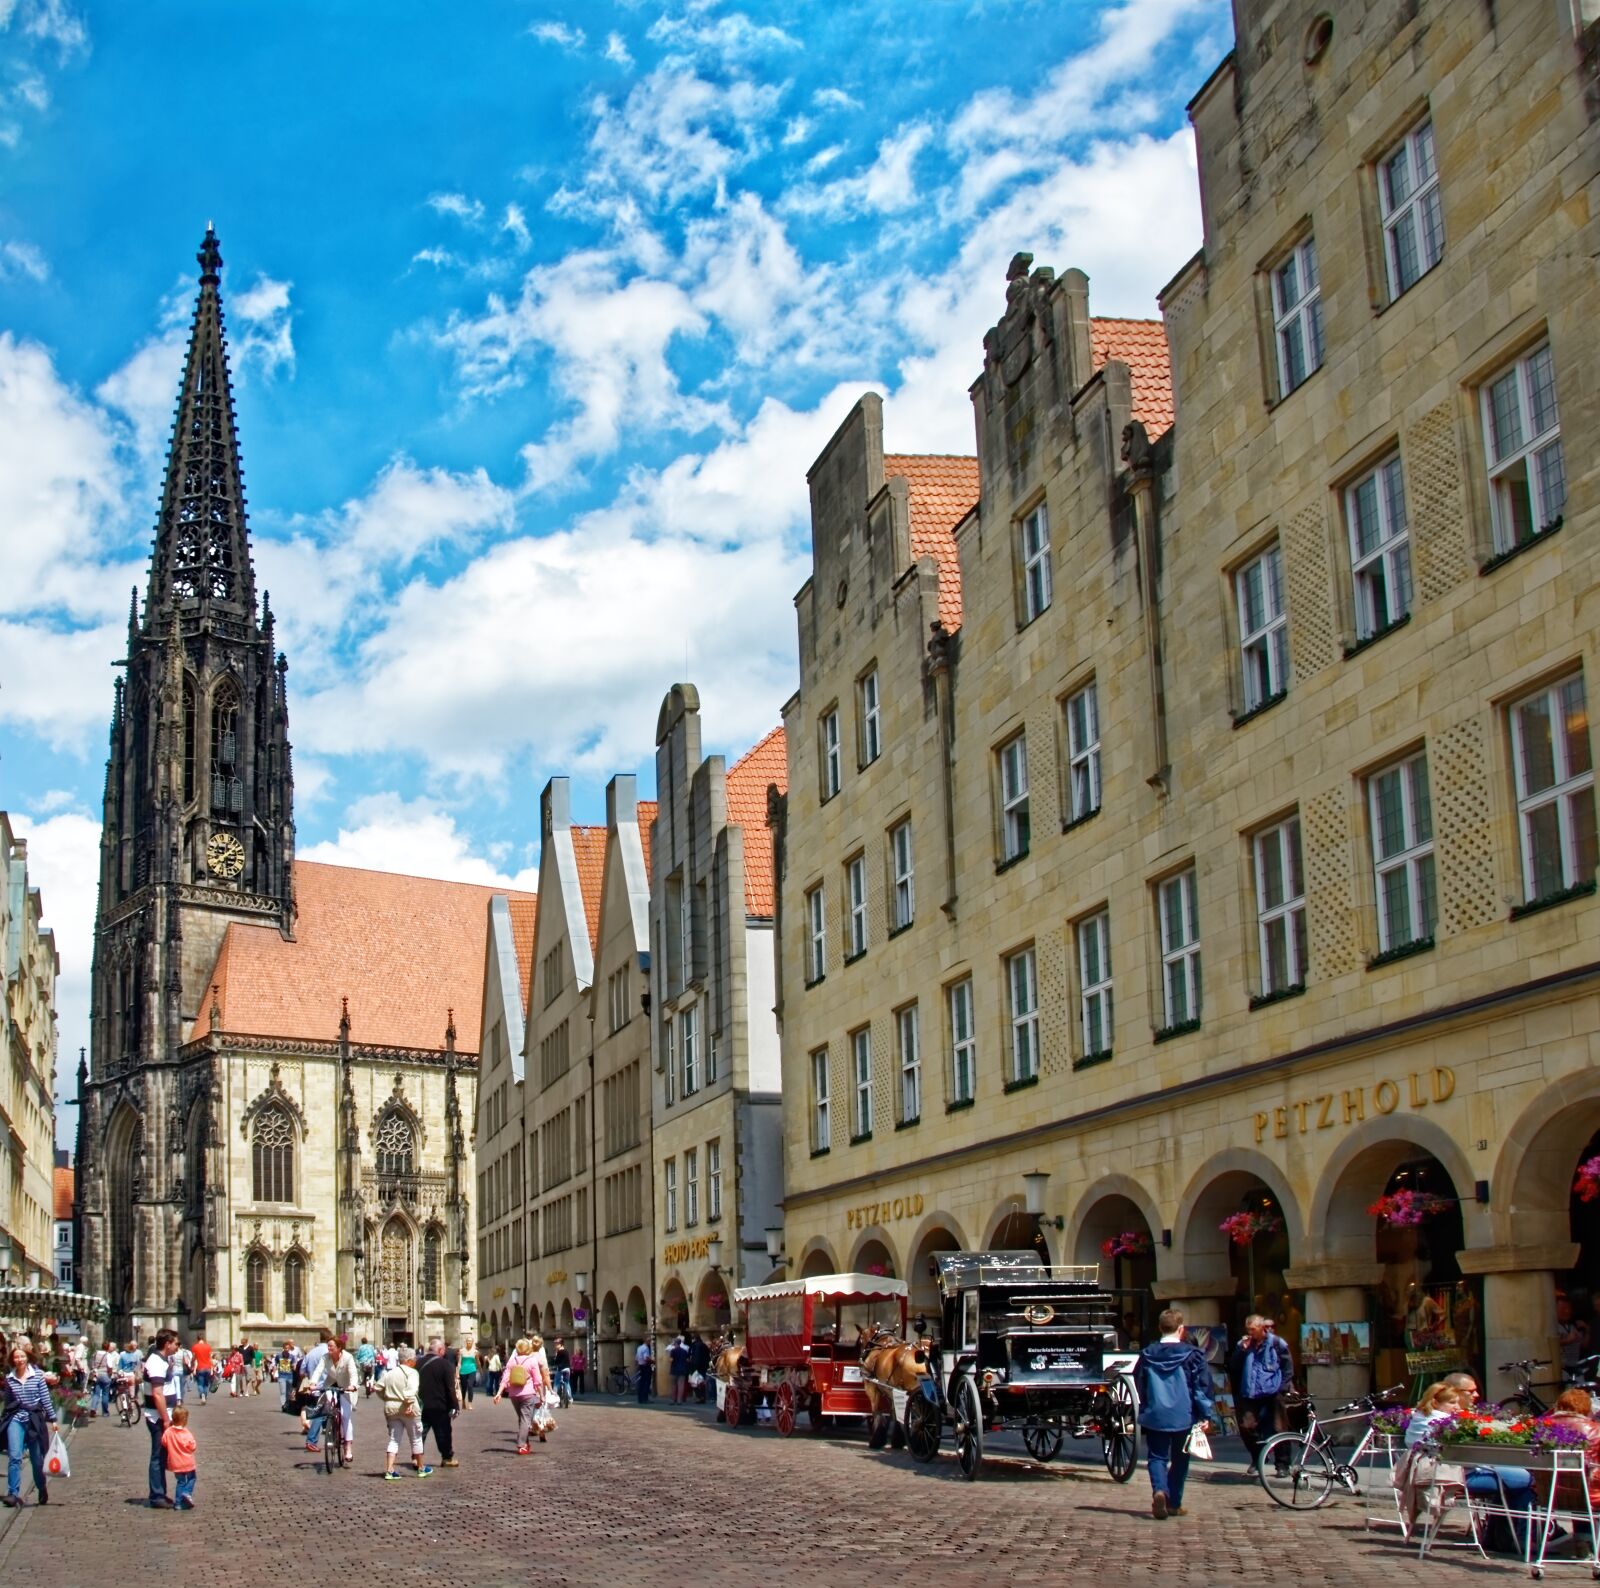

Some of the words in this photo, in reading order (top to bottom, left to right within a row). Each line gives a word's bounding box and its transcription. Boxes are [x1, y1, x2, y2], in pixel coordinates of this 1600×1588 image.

[1254, 1066, 1456, 1142] PETZHOLD
[848, 1193, 924, 1230] PETZHOLD
[664, 1240, 689, 1265] PHOTO
